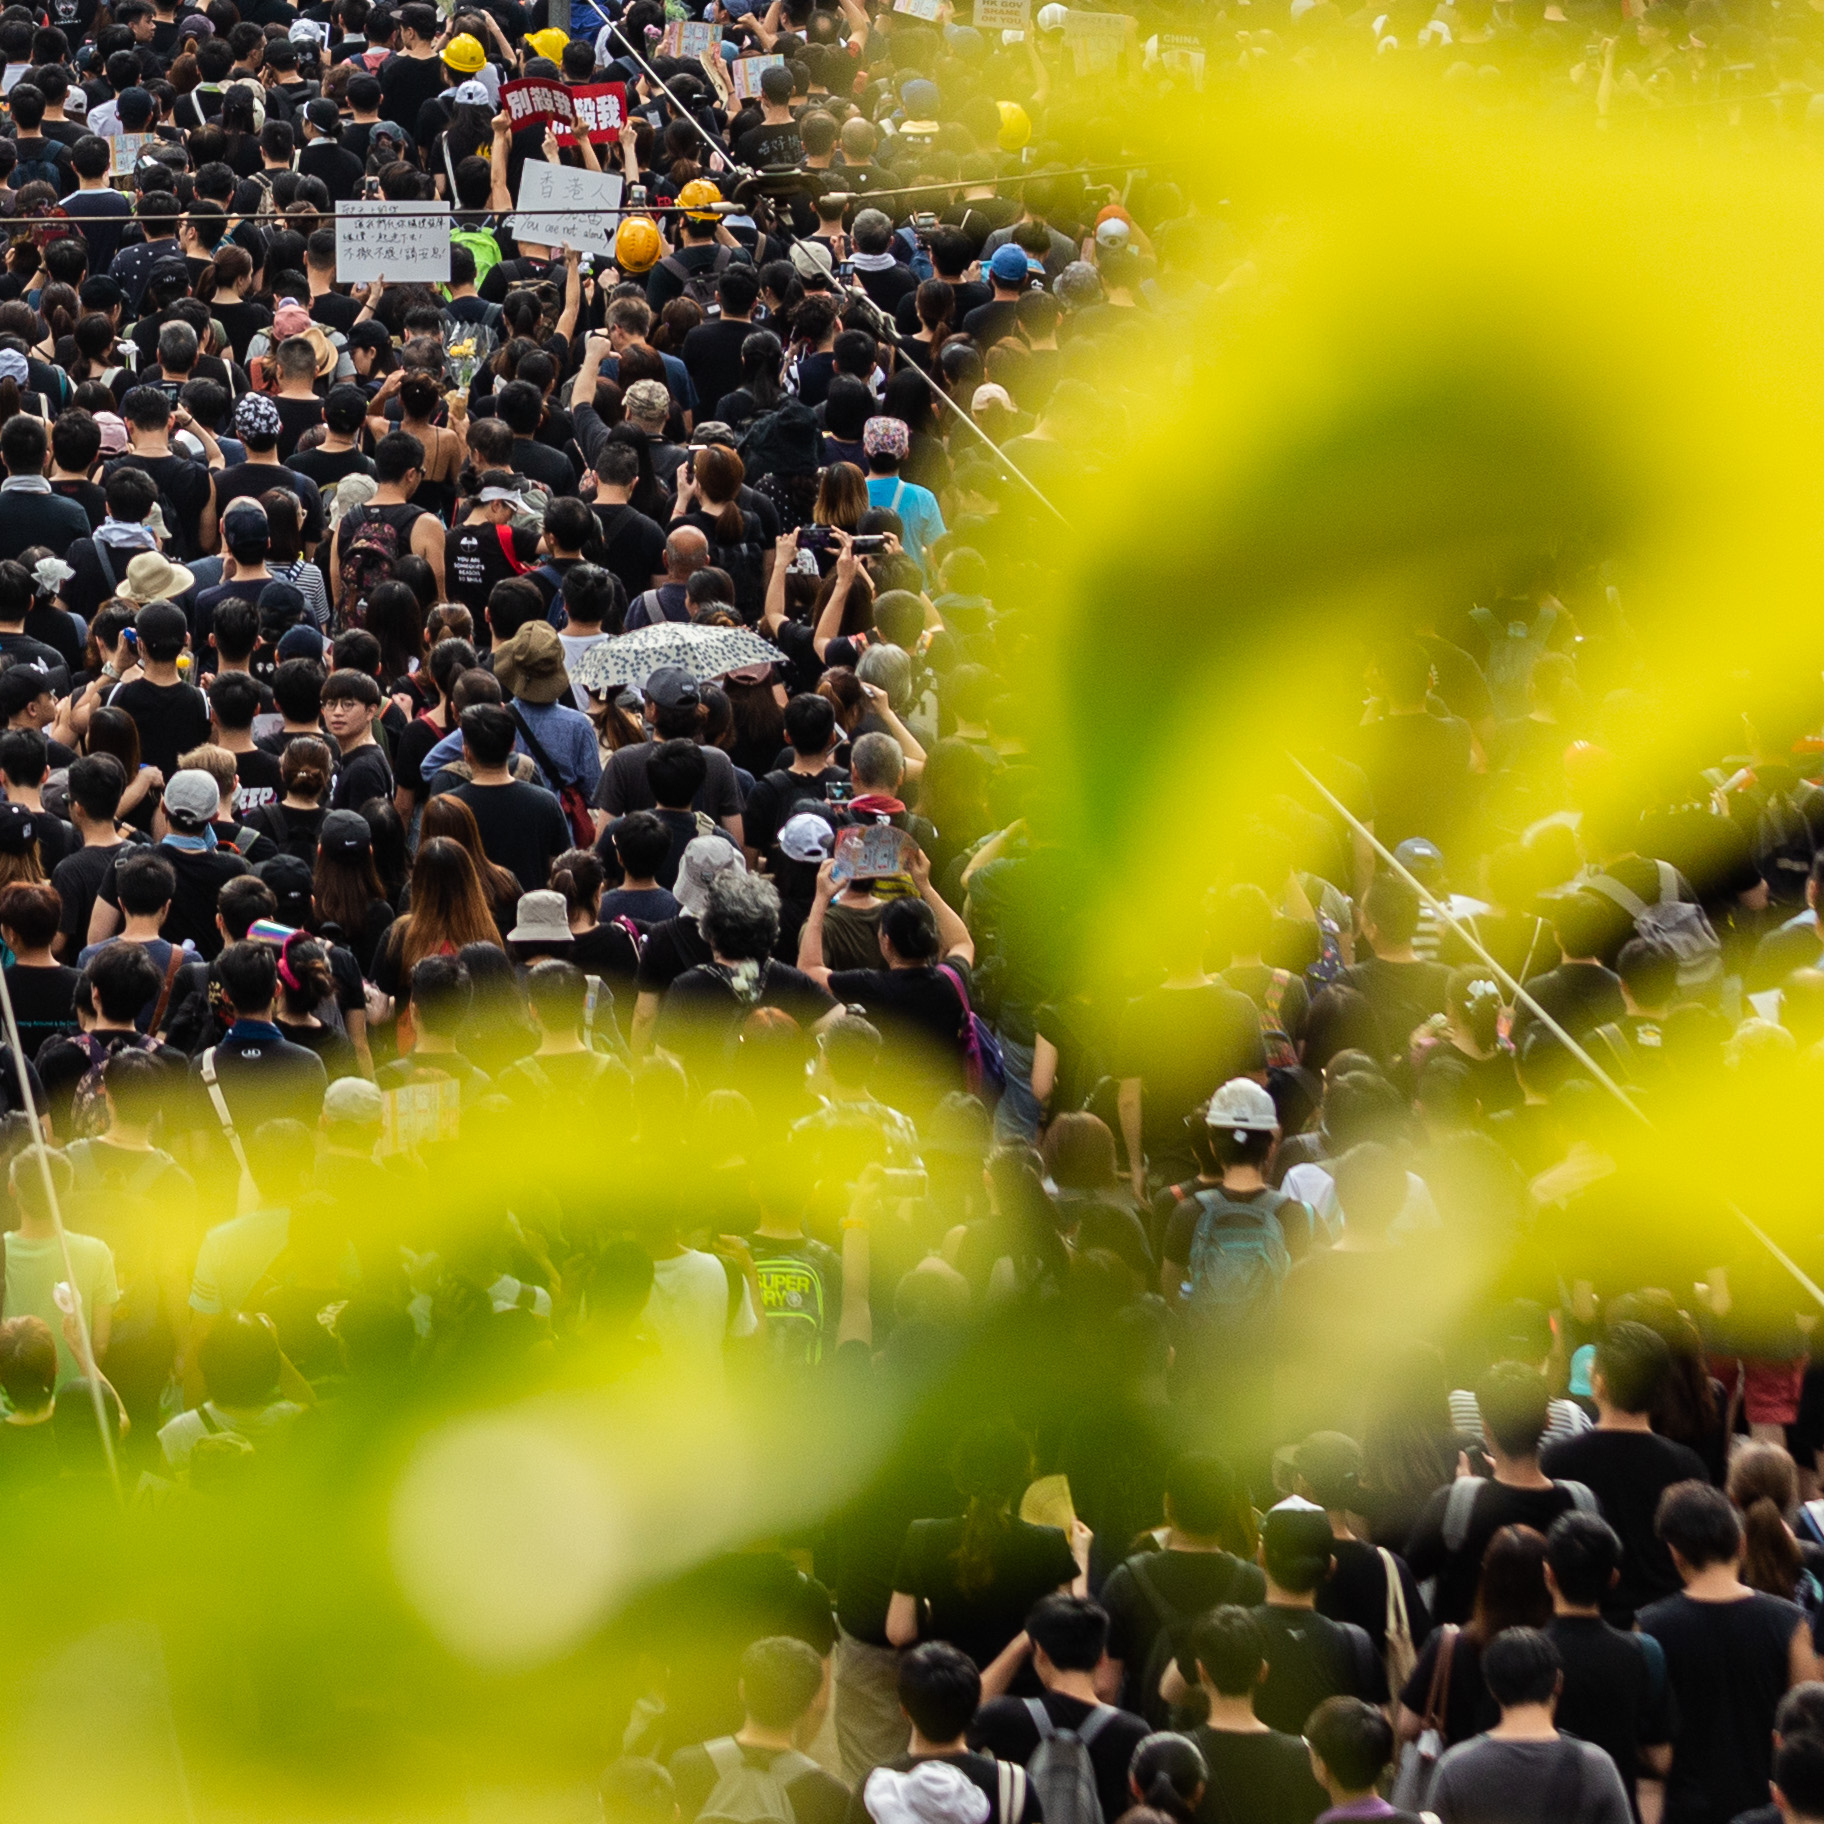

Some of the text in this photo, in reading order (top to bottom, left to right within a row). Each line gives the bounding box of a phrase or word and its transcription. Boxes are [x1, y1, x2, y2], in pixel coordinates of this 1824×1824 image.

[983, 8, 1020, 17] SHAME
[1000, 0, 1023, 10] GOV
[981, 15, 1022, 26] ON YOU
[1163, 35, 1201, 46] CHINA
[506, 90, 573, 119] 別殺我
[551, 94, 622, 135] 殺我
[540, 170, 614, 208] 香港人
[521, 213, 540, 233] You
[561, 224, 577, 237] not
[582, 229, 604, 242] alone
